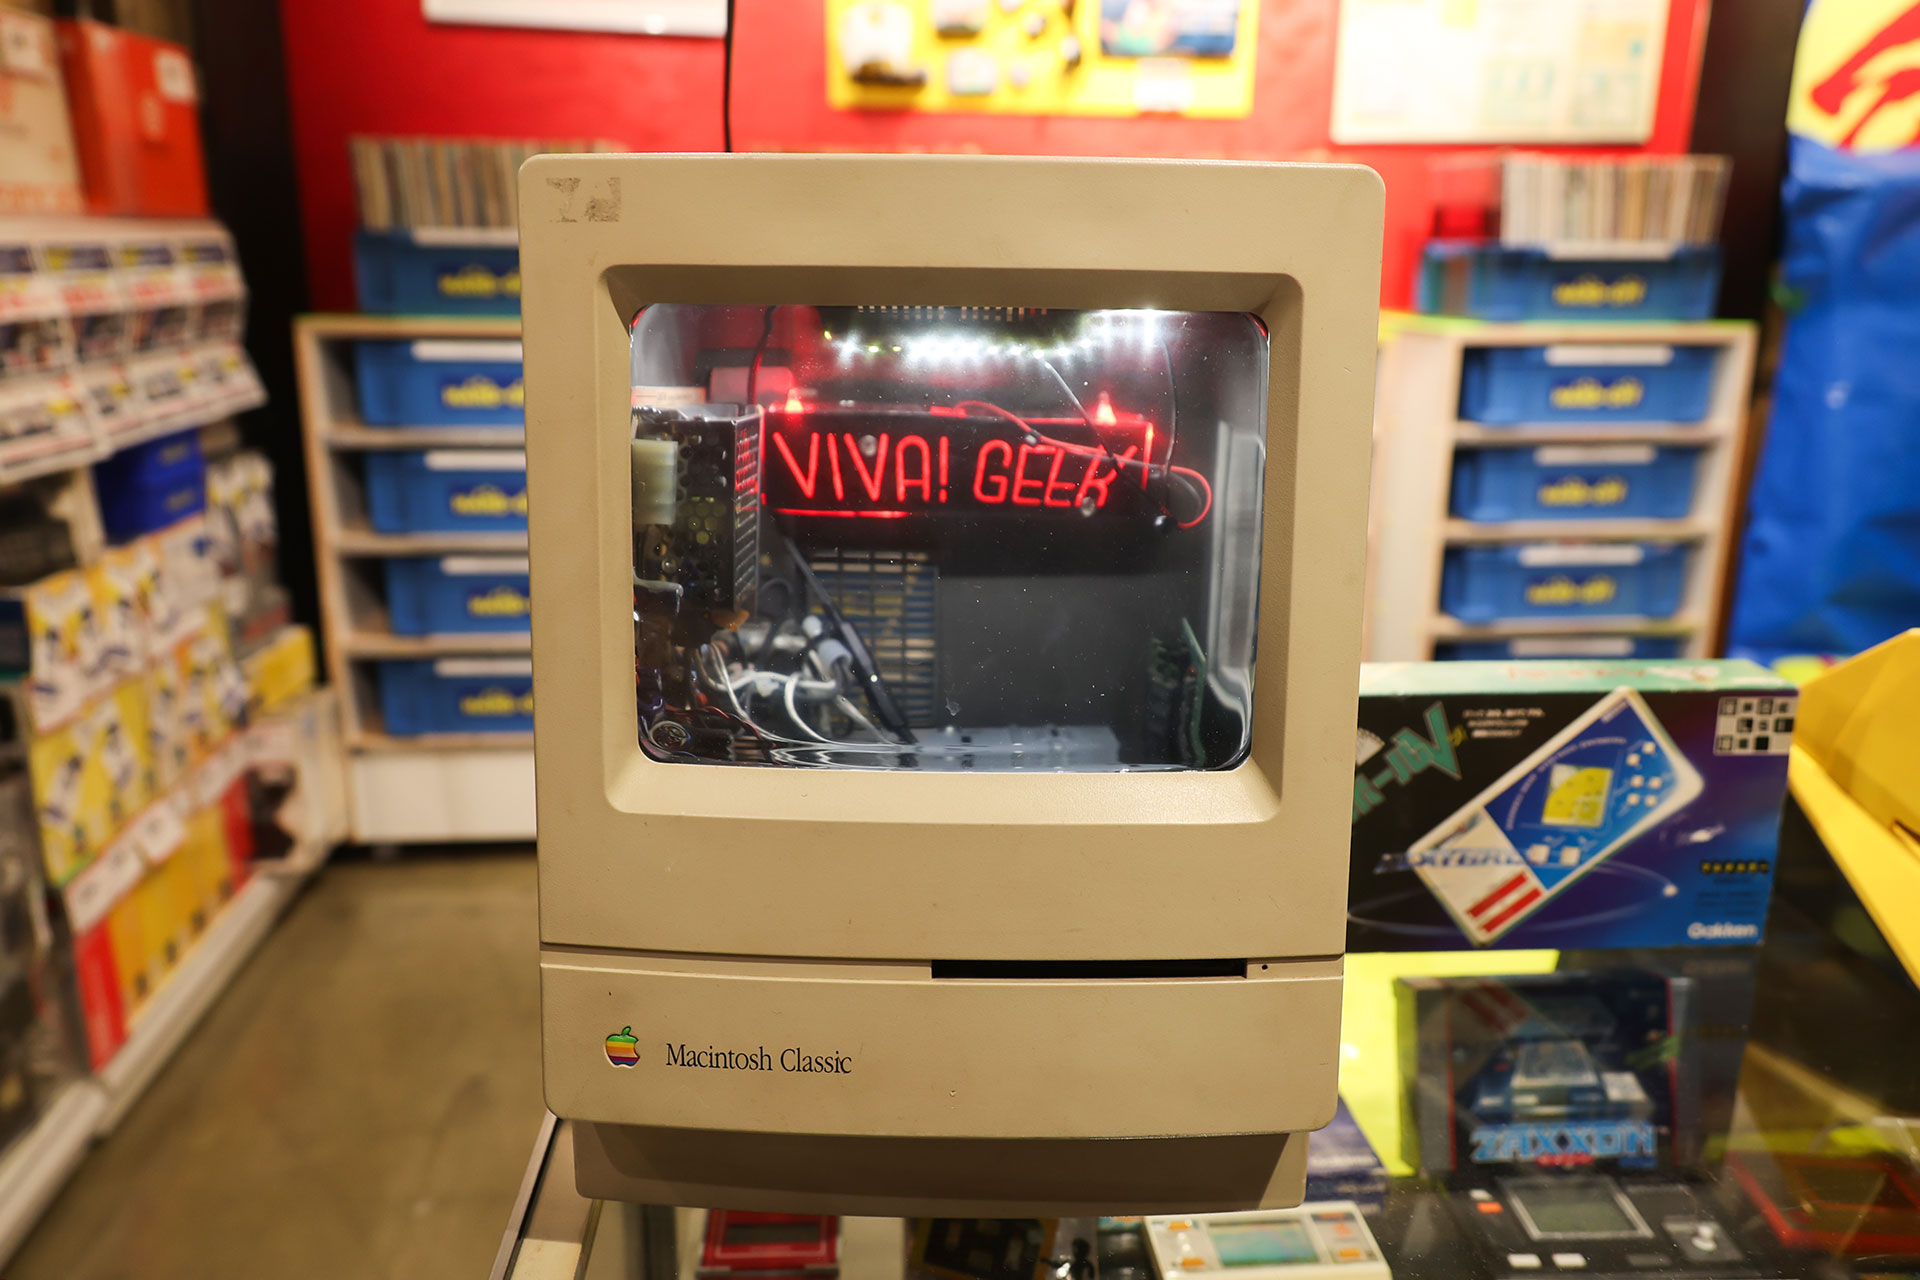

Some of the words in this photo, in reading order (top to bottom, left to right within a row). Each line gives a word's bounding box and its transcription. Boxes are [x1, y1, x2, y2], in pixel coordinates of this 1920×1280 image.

[772, 431, 949, 502] VIVA!
[972, 438, 1139, 508] GEEK
[665, 1042, 773, 1071] Macintosh
[780, 1047, 853, 1074] Classic
[1470, 1121, 1657, 1164] ZAXXON
